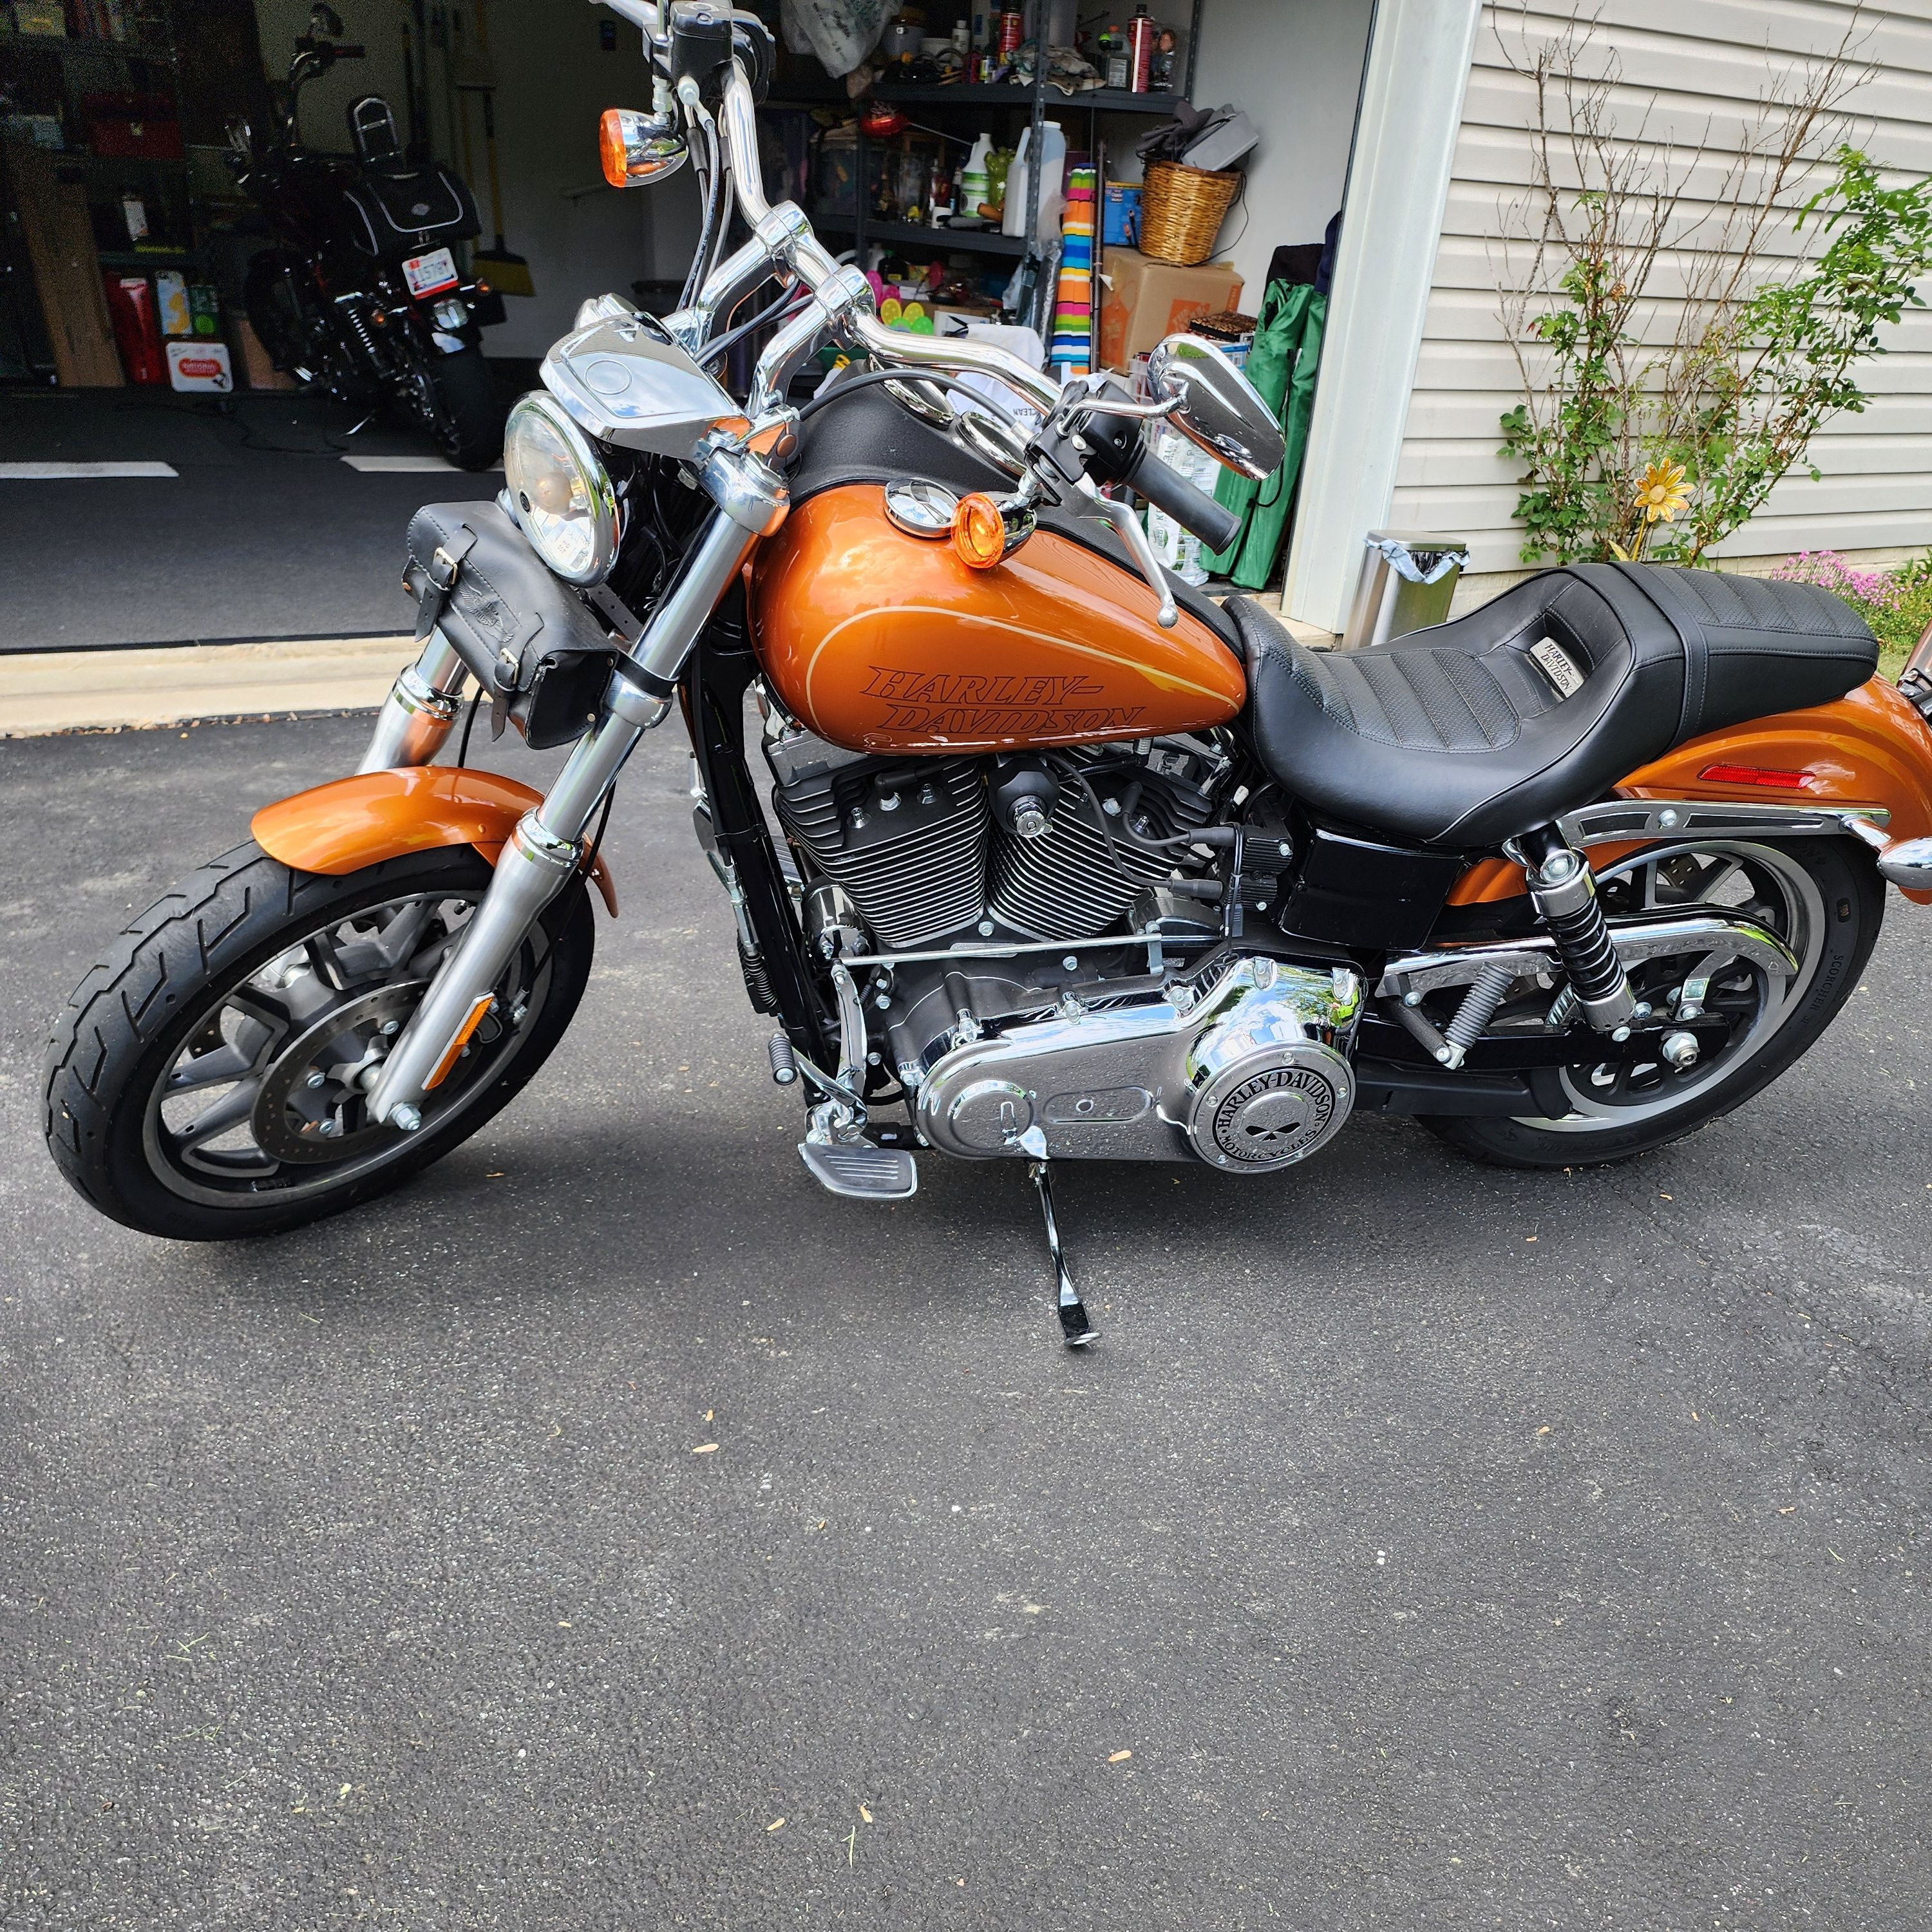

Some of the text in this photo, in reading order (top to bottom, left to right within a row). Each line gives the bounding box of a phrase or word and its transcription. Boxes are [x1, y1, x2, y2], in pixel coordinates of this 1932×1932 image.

[1540, 654, 1572, 690] DAVIDSON
[876, 703, 1146, 734] DAVIDSON
[1810, 954, 1844, 1012] SCORCHER
[1217, 1071, 1331, 1128] HARLEY-DAVIDSON
[1219, 1128, 1318, 1160] MOTORCYCLES
